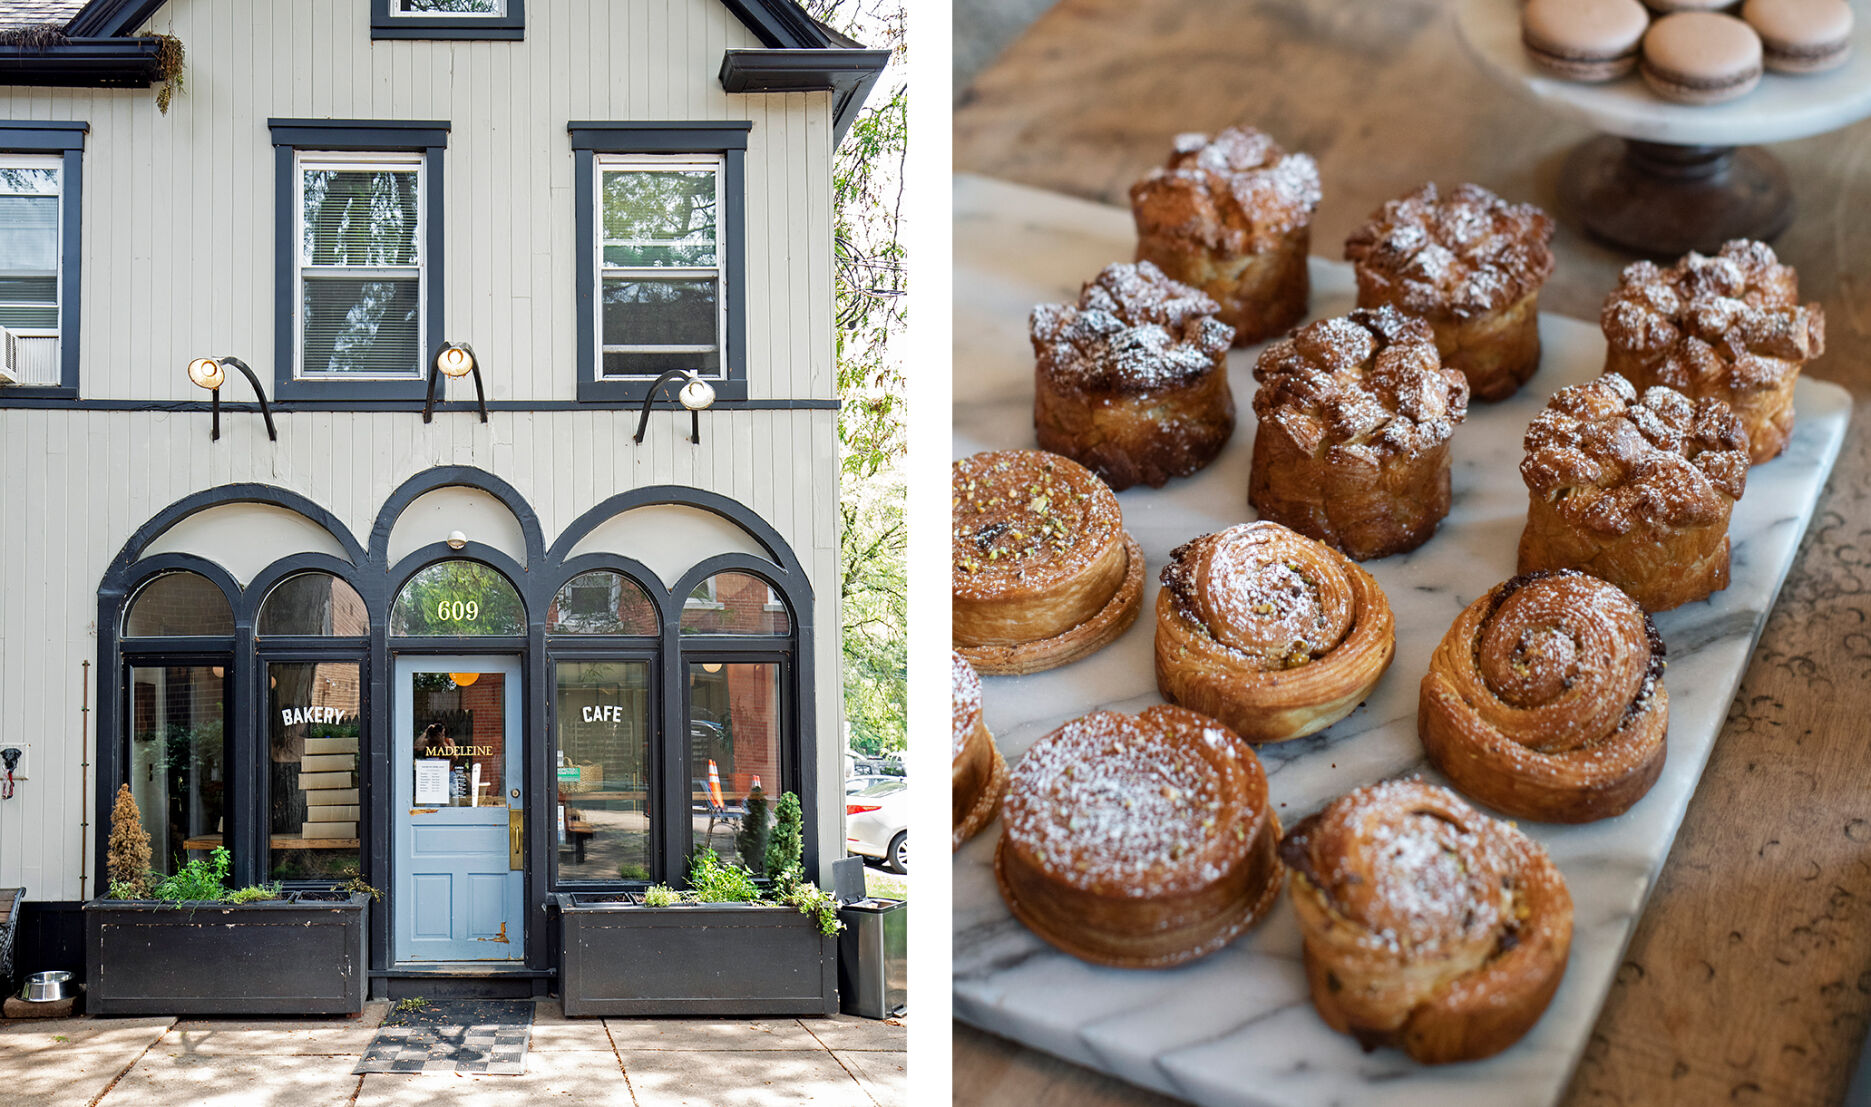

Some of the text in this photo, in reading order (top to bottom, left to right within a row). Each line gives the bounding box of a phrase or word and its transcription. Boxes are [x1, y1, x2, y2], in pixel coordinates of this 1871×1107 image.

[437, 600, 479, 621] 609
[281, 706, 345, 726] BAKERY
[582, 705, 623, 723] CAFE
[425, 745, 494, 757] MADELEINE
